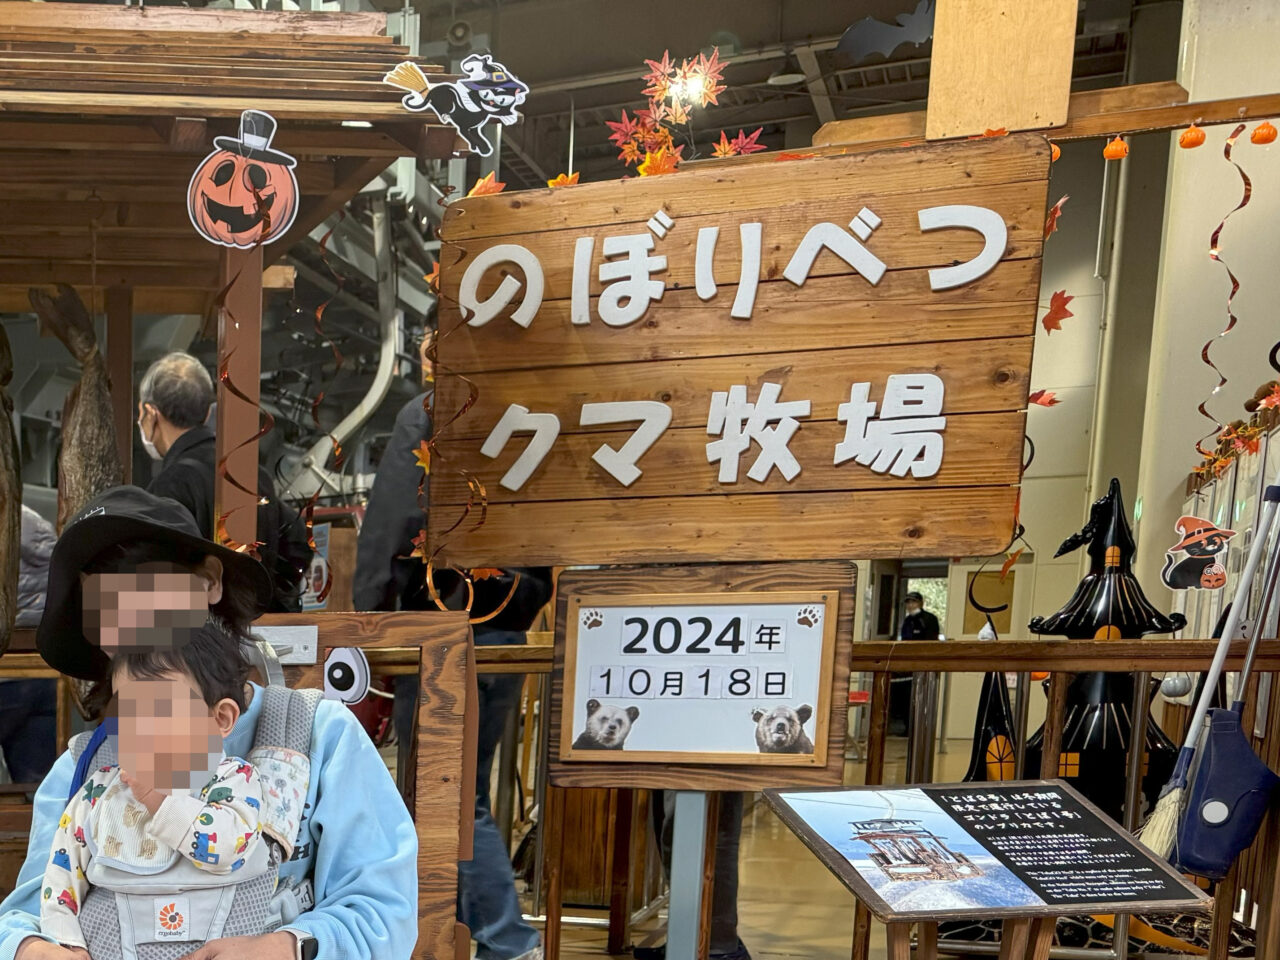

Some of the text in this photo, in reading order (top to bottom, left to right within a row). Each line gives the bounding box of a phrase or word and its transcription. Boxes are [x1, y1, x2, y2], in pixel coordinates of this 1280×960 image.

[459, 205, 1008, 329] のぼりべつ
[480, 373, 946, 492] クマ牧場
[622, 616, 781, 653] 2024年
[599, 668, 786, 697] 10月18日
